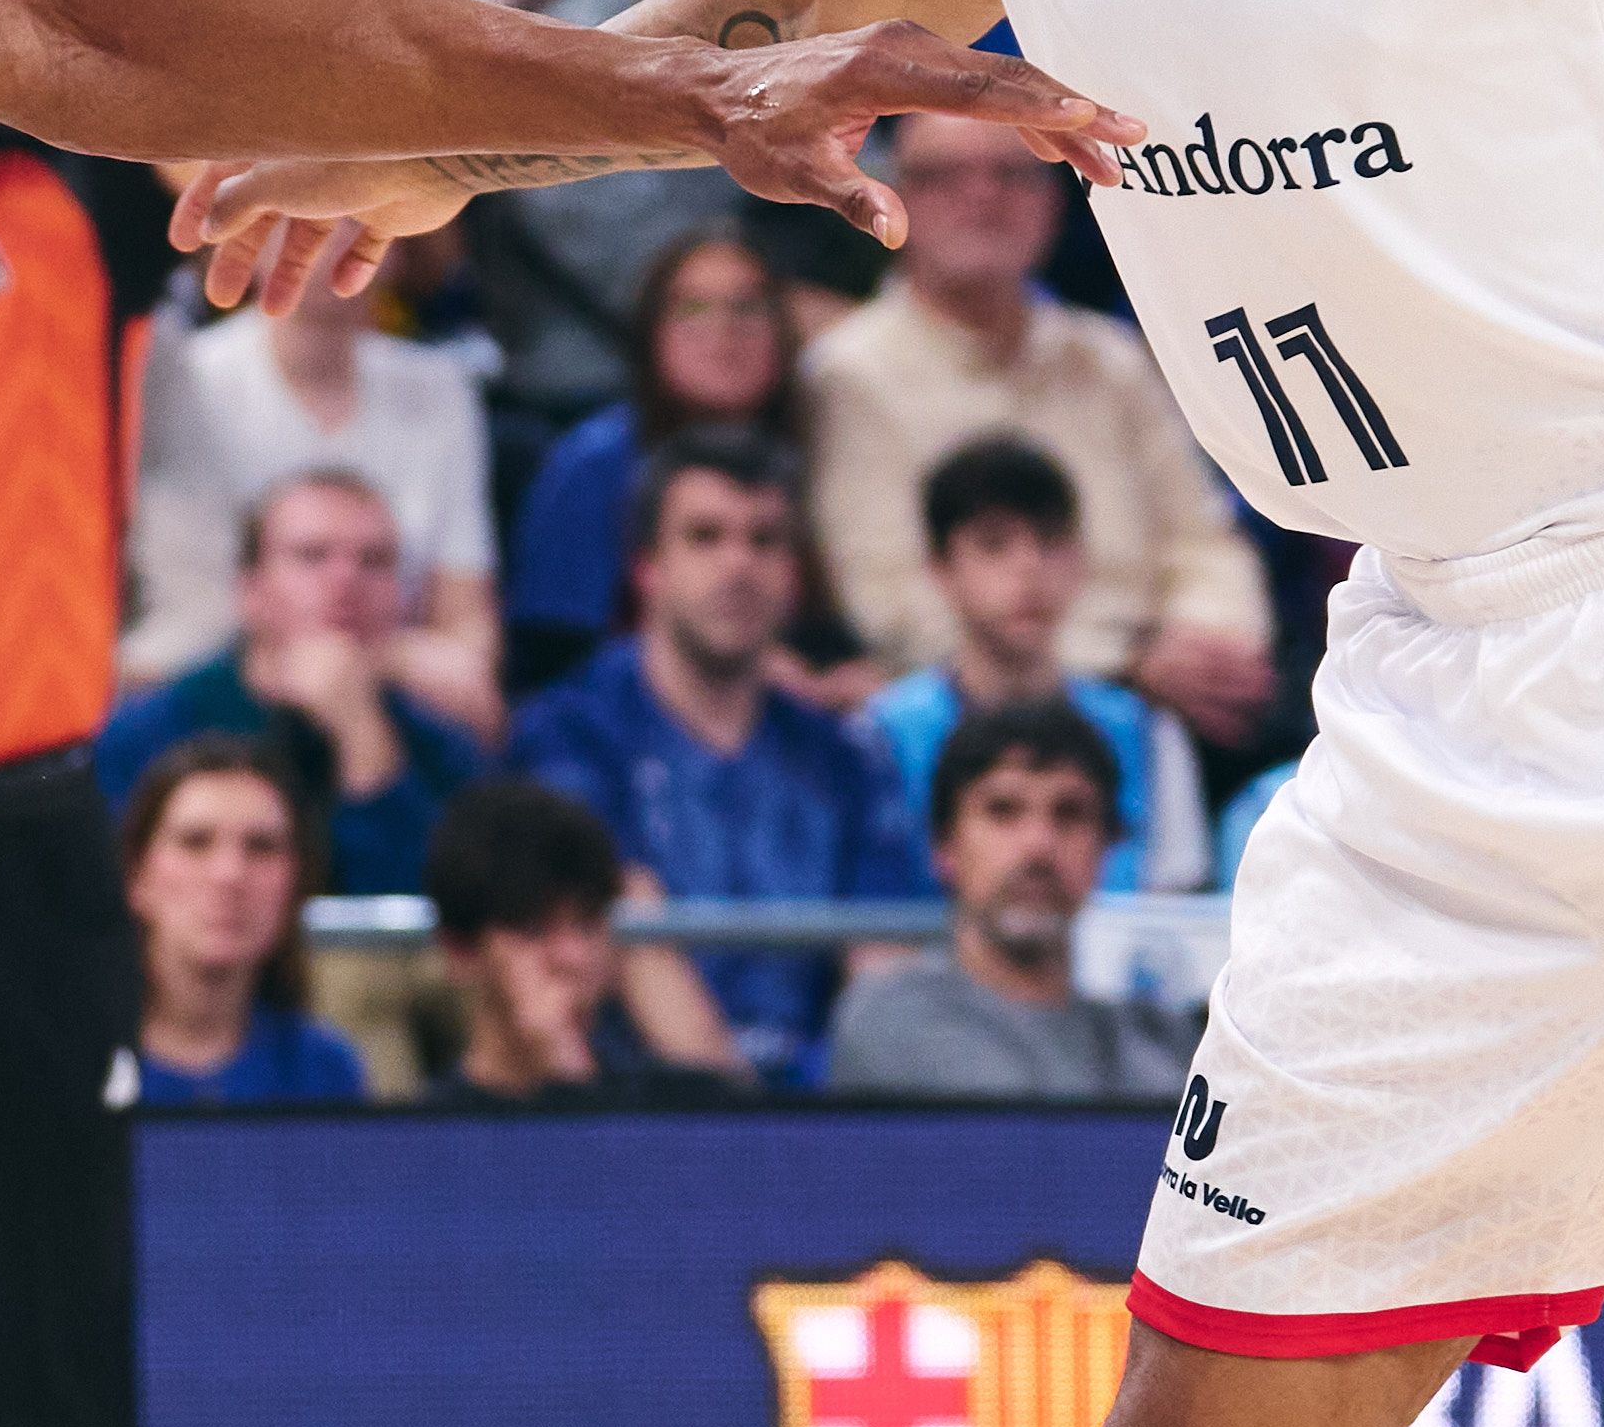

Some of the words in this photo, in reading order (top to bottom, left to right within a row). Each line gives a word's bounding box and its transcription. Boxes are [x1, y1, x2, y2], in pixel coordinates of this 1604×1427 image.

[1113, 112, 1414, 196] Andorra
[1204, 302, 1411, 488] 11
[1203, 1182, 1267, 1225] Vella
